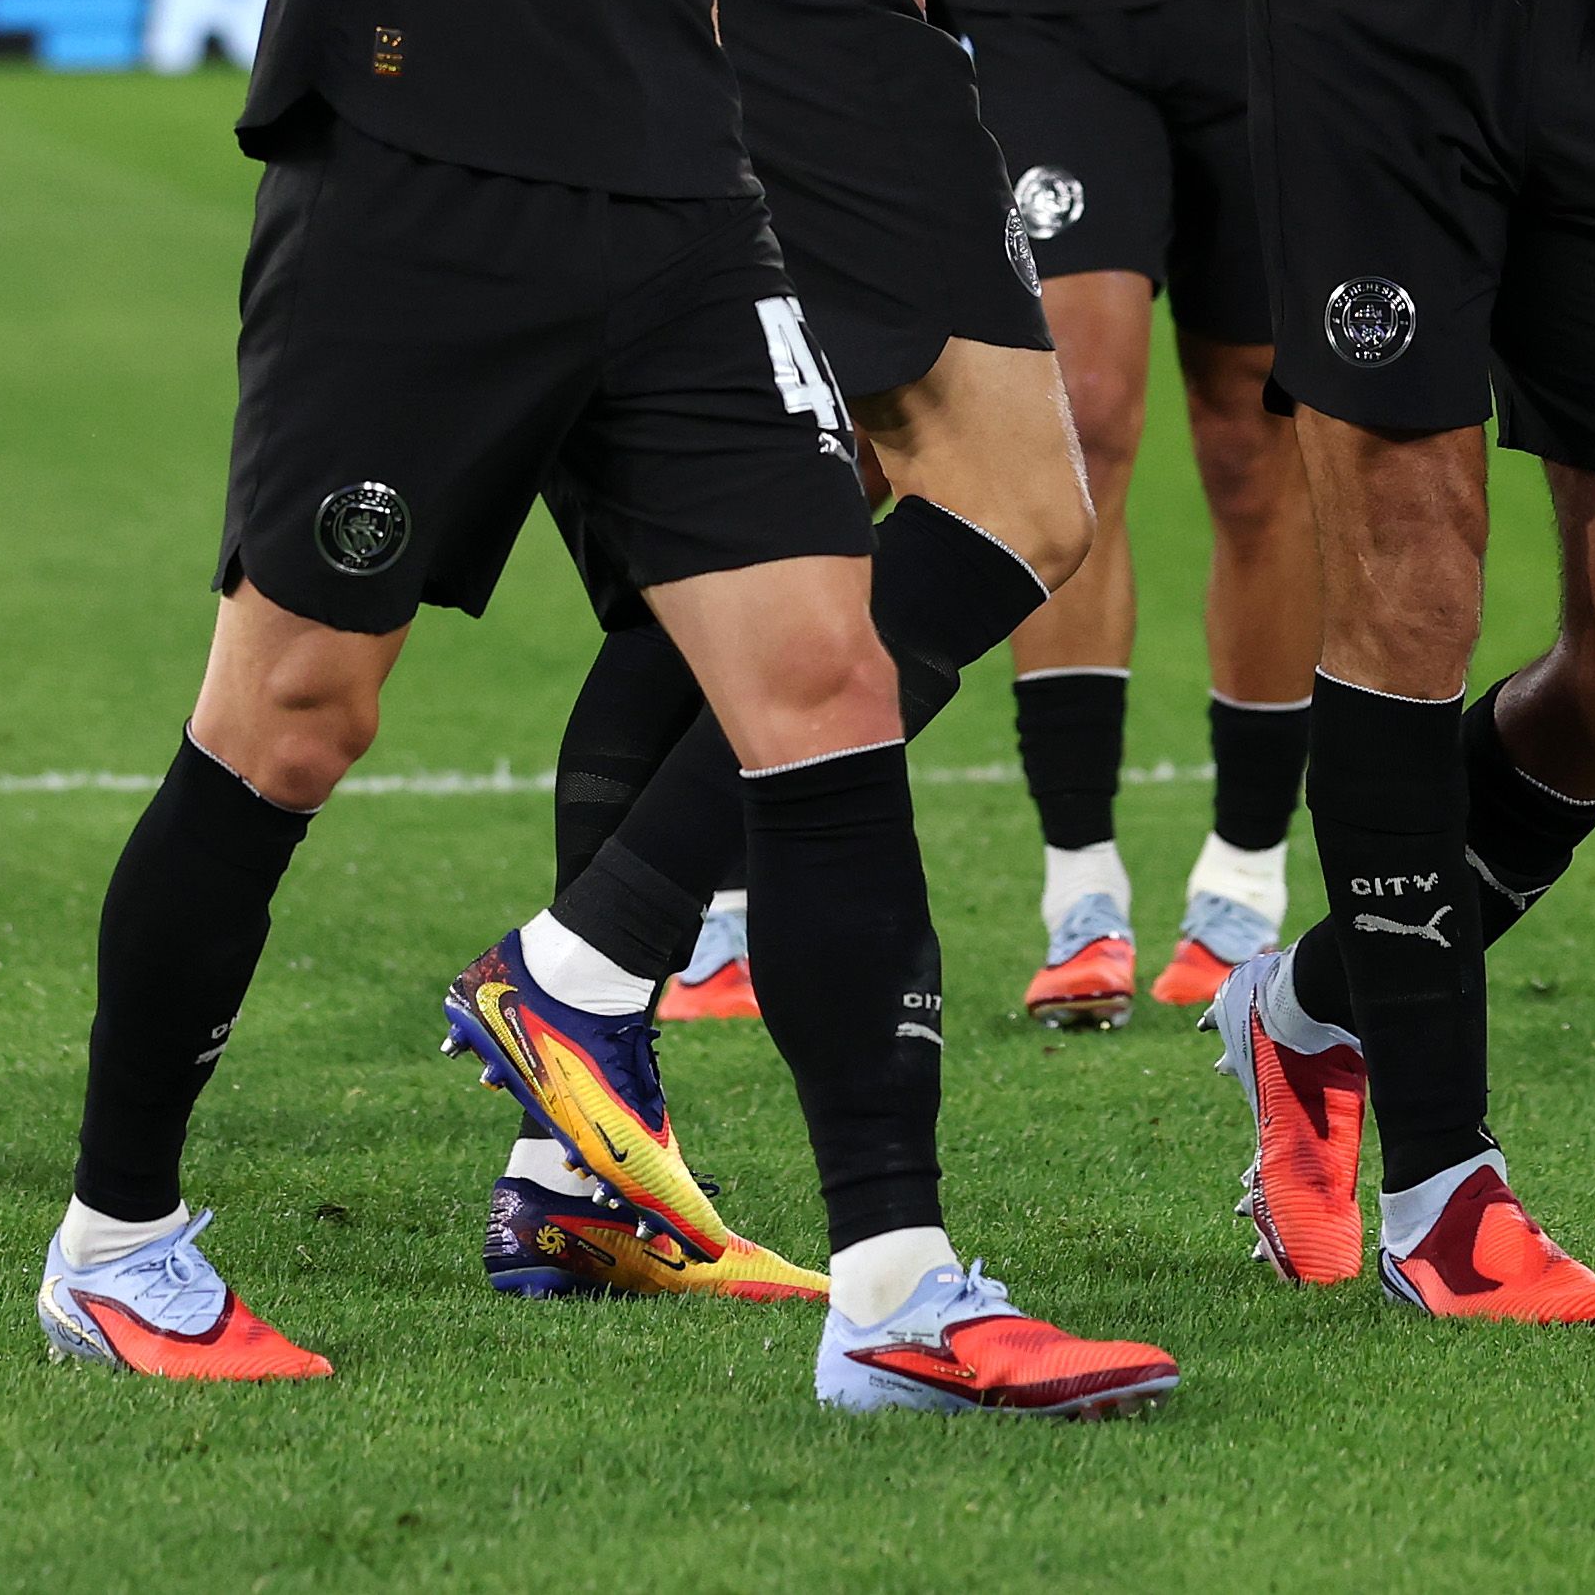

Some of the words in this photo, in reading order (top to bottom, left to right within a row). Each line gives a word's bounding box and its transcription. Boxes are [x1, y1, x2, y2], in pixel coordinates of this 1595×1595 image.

[755, 295, 855, 432] 4
[1350, 871, 1440, 897] CITY
[902, 991, 943, 1012] CIT
